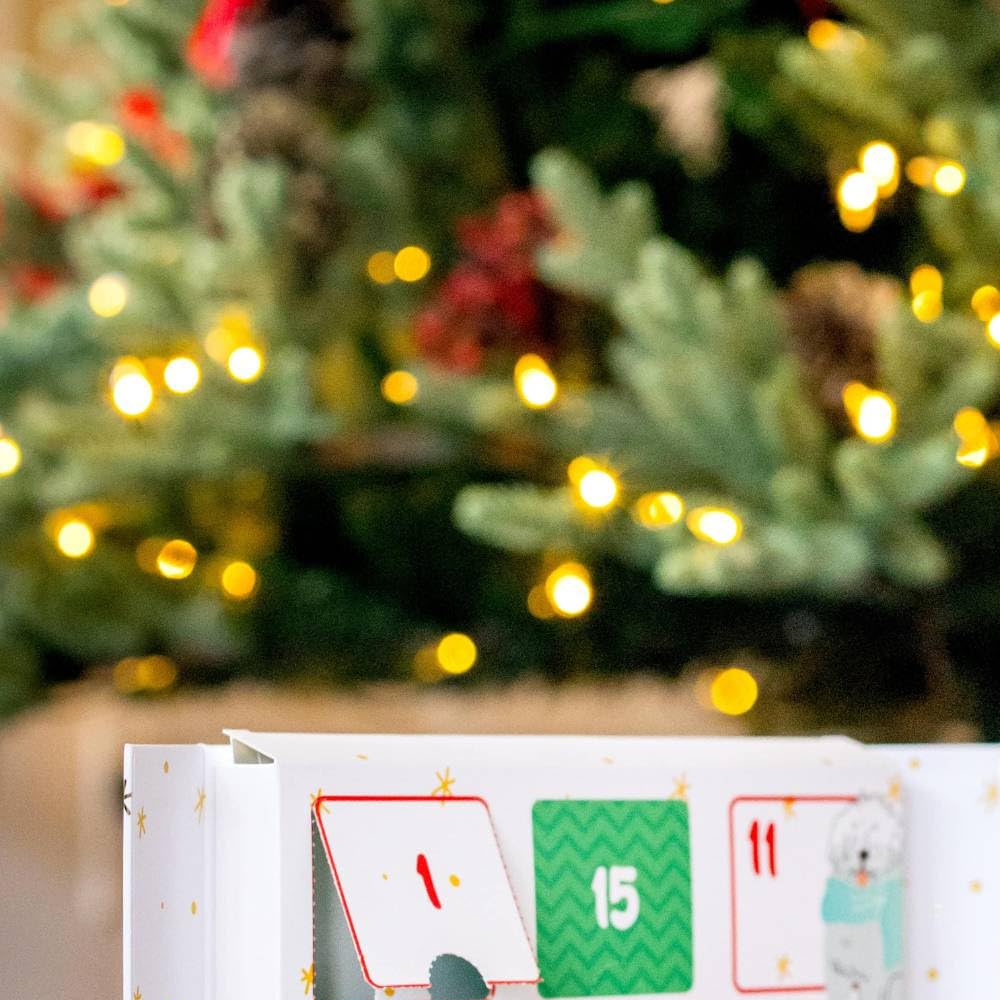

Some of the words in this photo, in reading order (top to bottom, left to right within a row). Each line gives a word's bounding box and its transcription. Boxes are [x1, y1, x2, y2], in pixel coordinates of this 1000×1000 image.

[749, 820, 777, 876] 11
[416, 854, 442, 910] 1
[591, 866, 640, 931] 15
